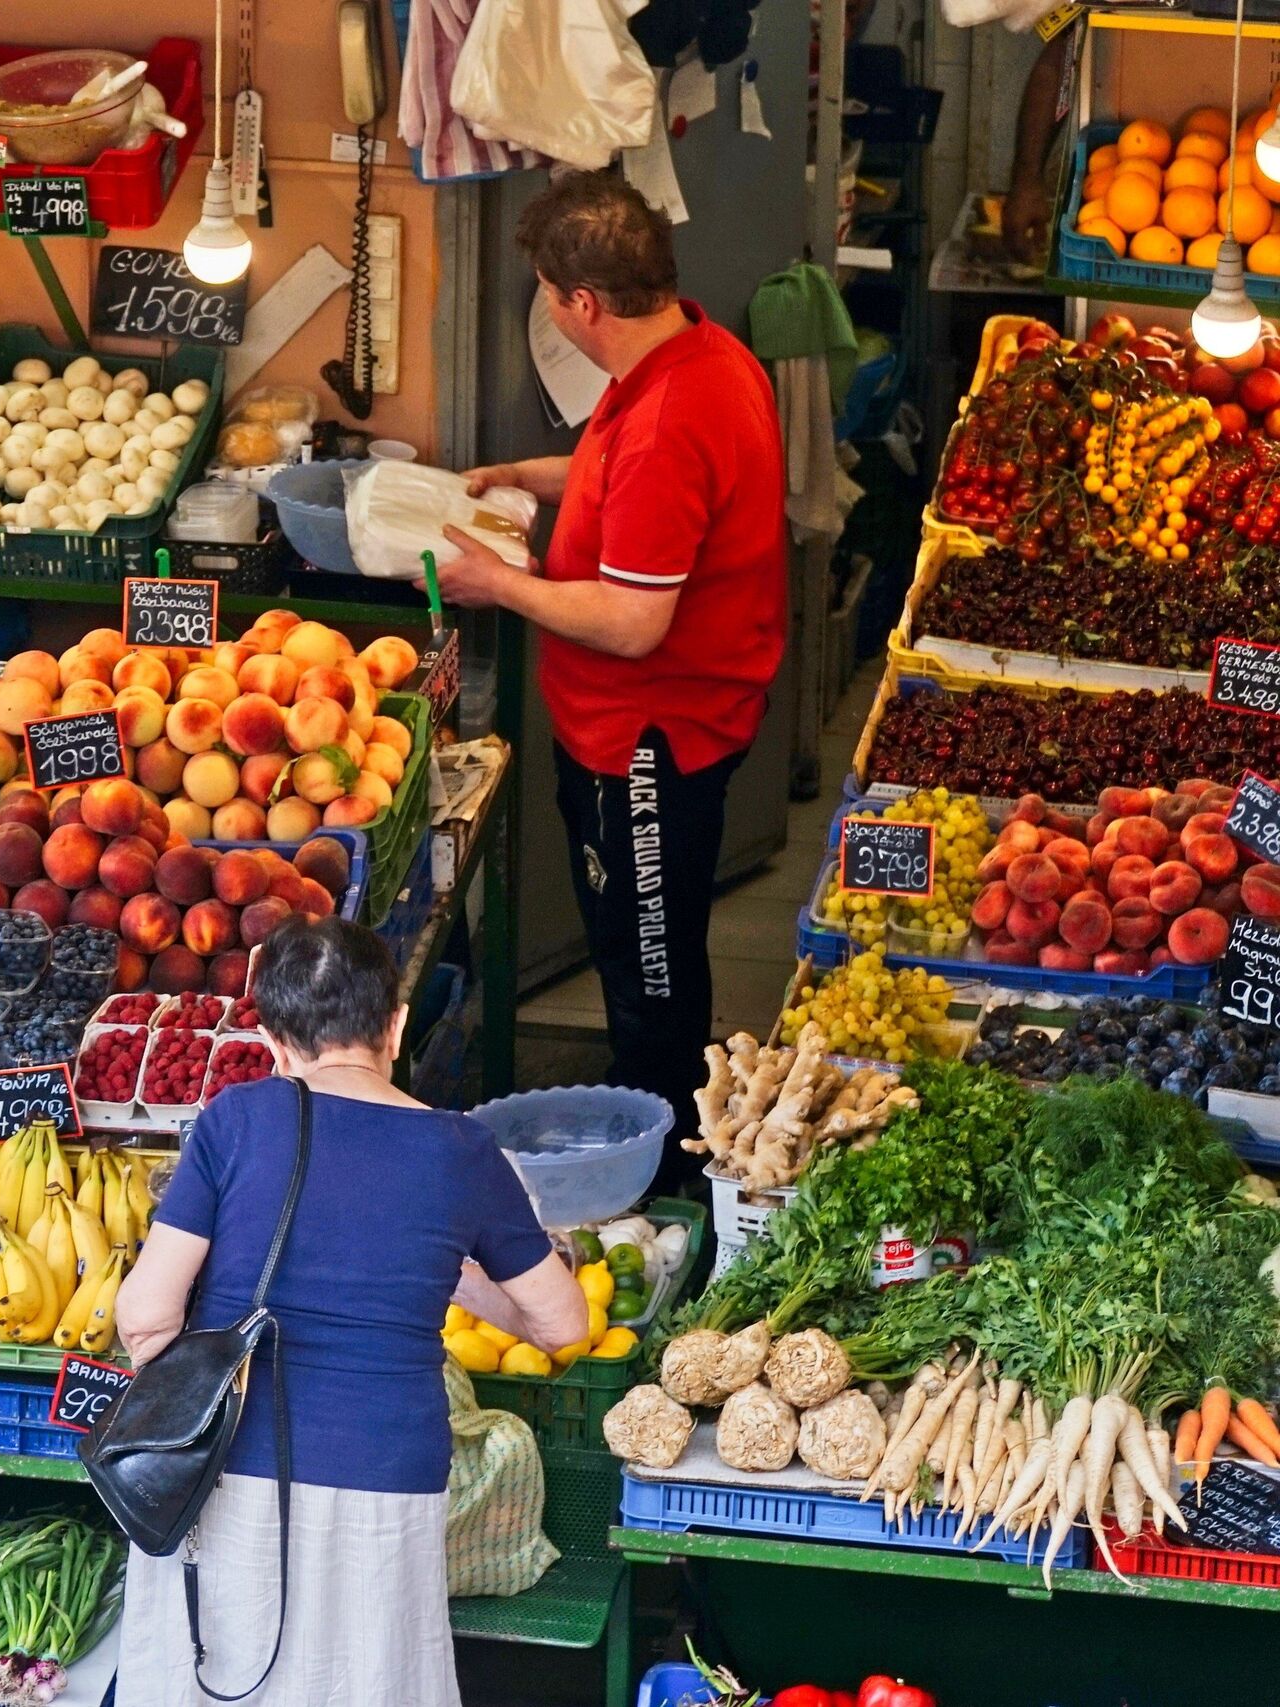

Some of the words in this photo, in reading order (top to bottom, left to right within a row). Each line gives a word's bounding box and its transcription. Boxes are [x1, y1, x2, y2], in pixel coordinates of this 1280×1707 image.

[629, 749, 658, 817] BLACK
[632, 822, 662, 893] SQUAD
[855, 846, 928, 888] 3798
[638, 895, 670, 997] PROJECTS
[885, 1240, 914, 1257] tejfö
